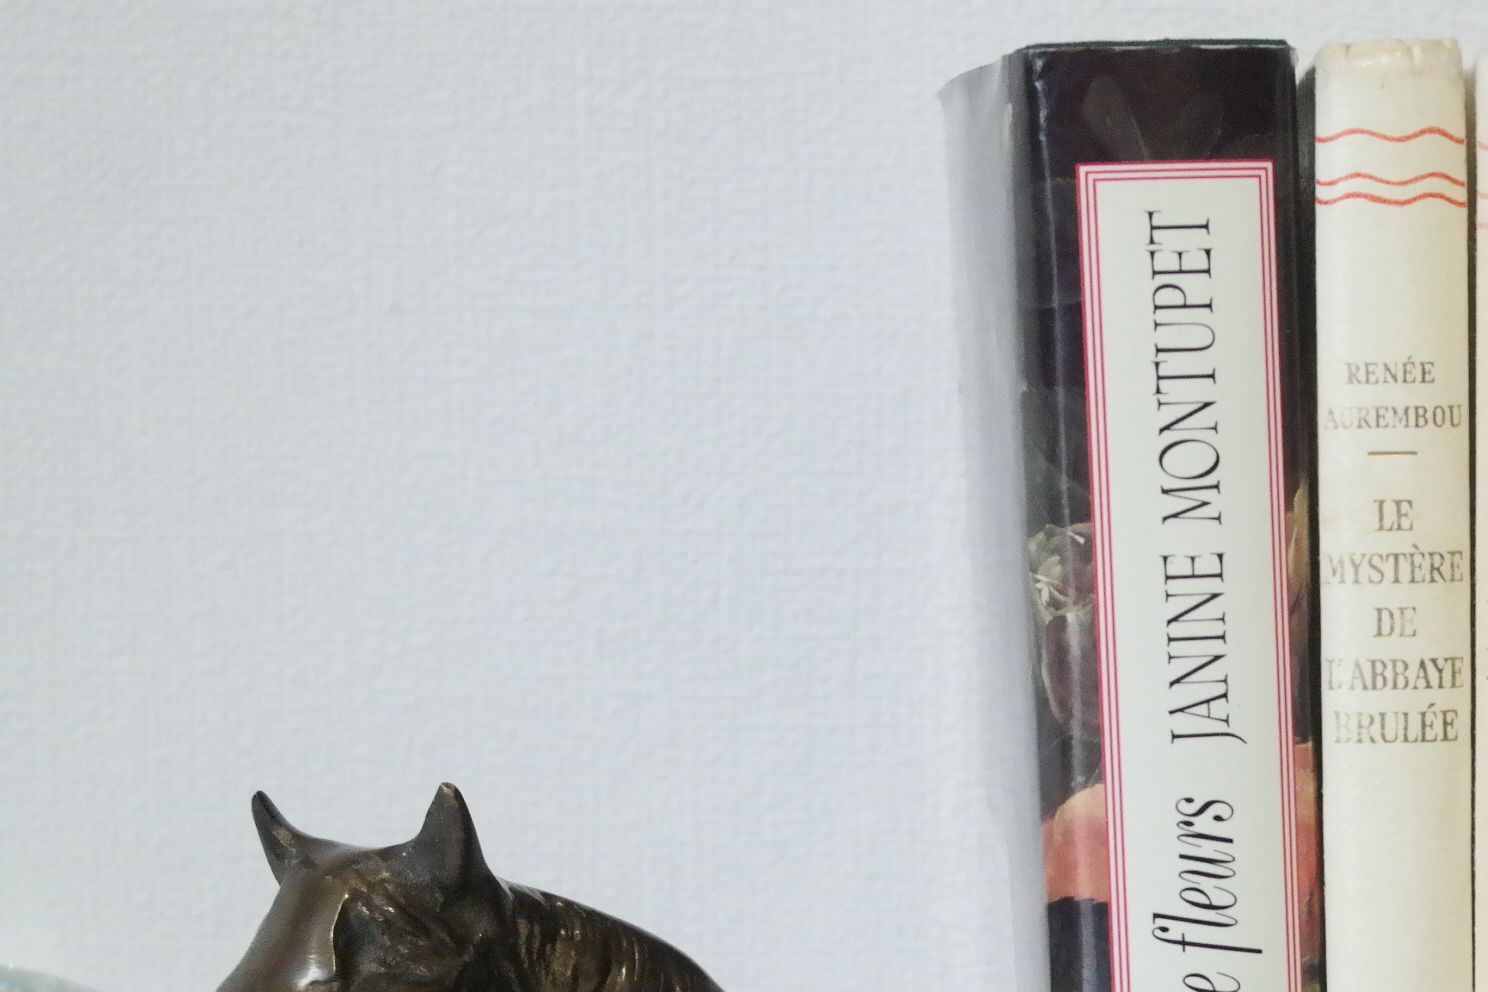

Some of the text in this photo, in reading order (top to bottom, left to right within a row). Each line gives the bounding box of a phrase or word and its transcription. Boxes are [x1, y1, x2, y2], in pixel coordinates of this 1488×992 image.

[1345, 355, 1436, 386] RENÉE
[1324, 404, 1463, 430] AUREMBOU
[1145, 210, 1247, 744] JANINE MONTUPET
[1373, 499, 1414, 532] LE
[1323, 543, 1464, 586] MYSTÈRE
[1373, 606, 1417, 638] DE
[1325, 656, 1464, 692] L'ABBAYE
[1334, 702, 1459, 745] BRULÉE
[1152, 797, 1263, 954] fleurs
